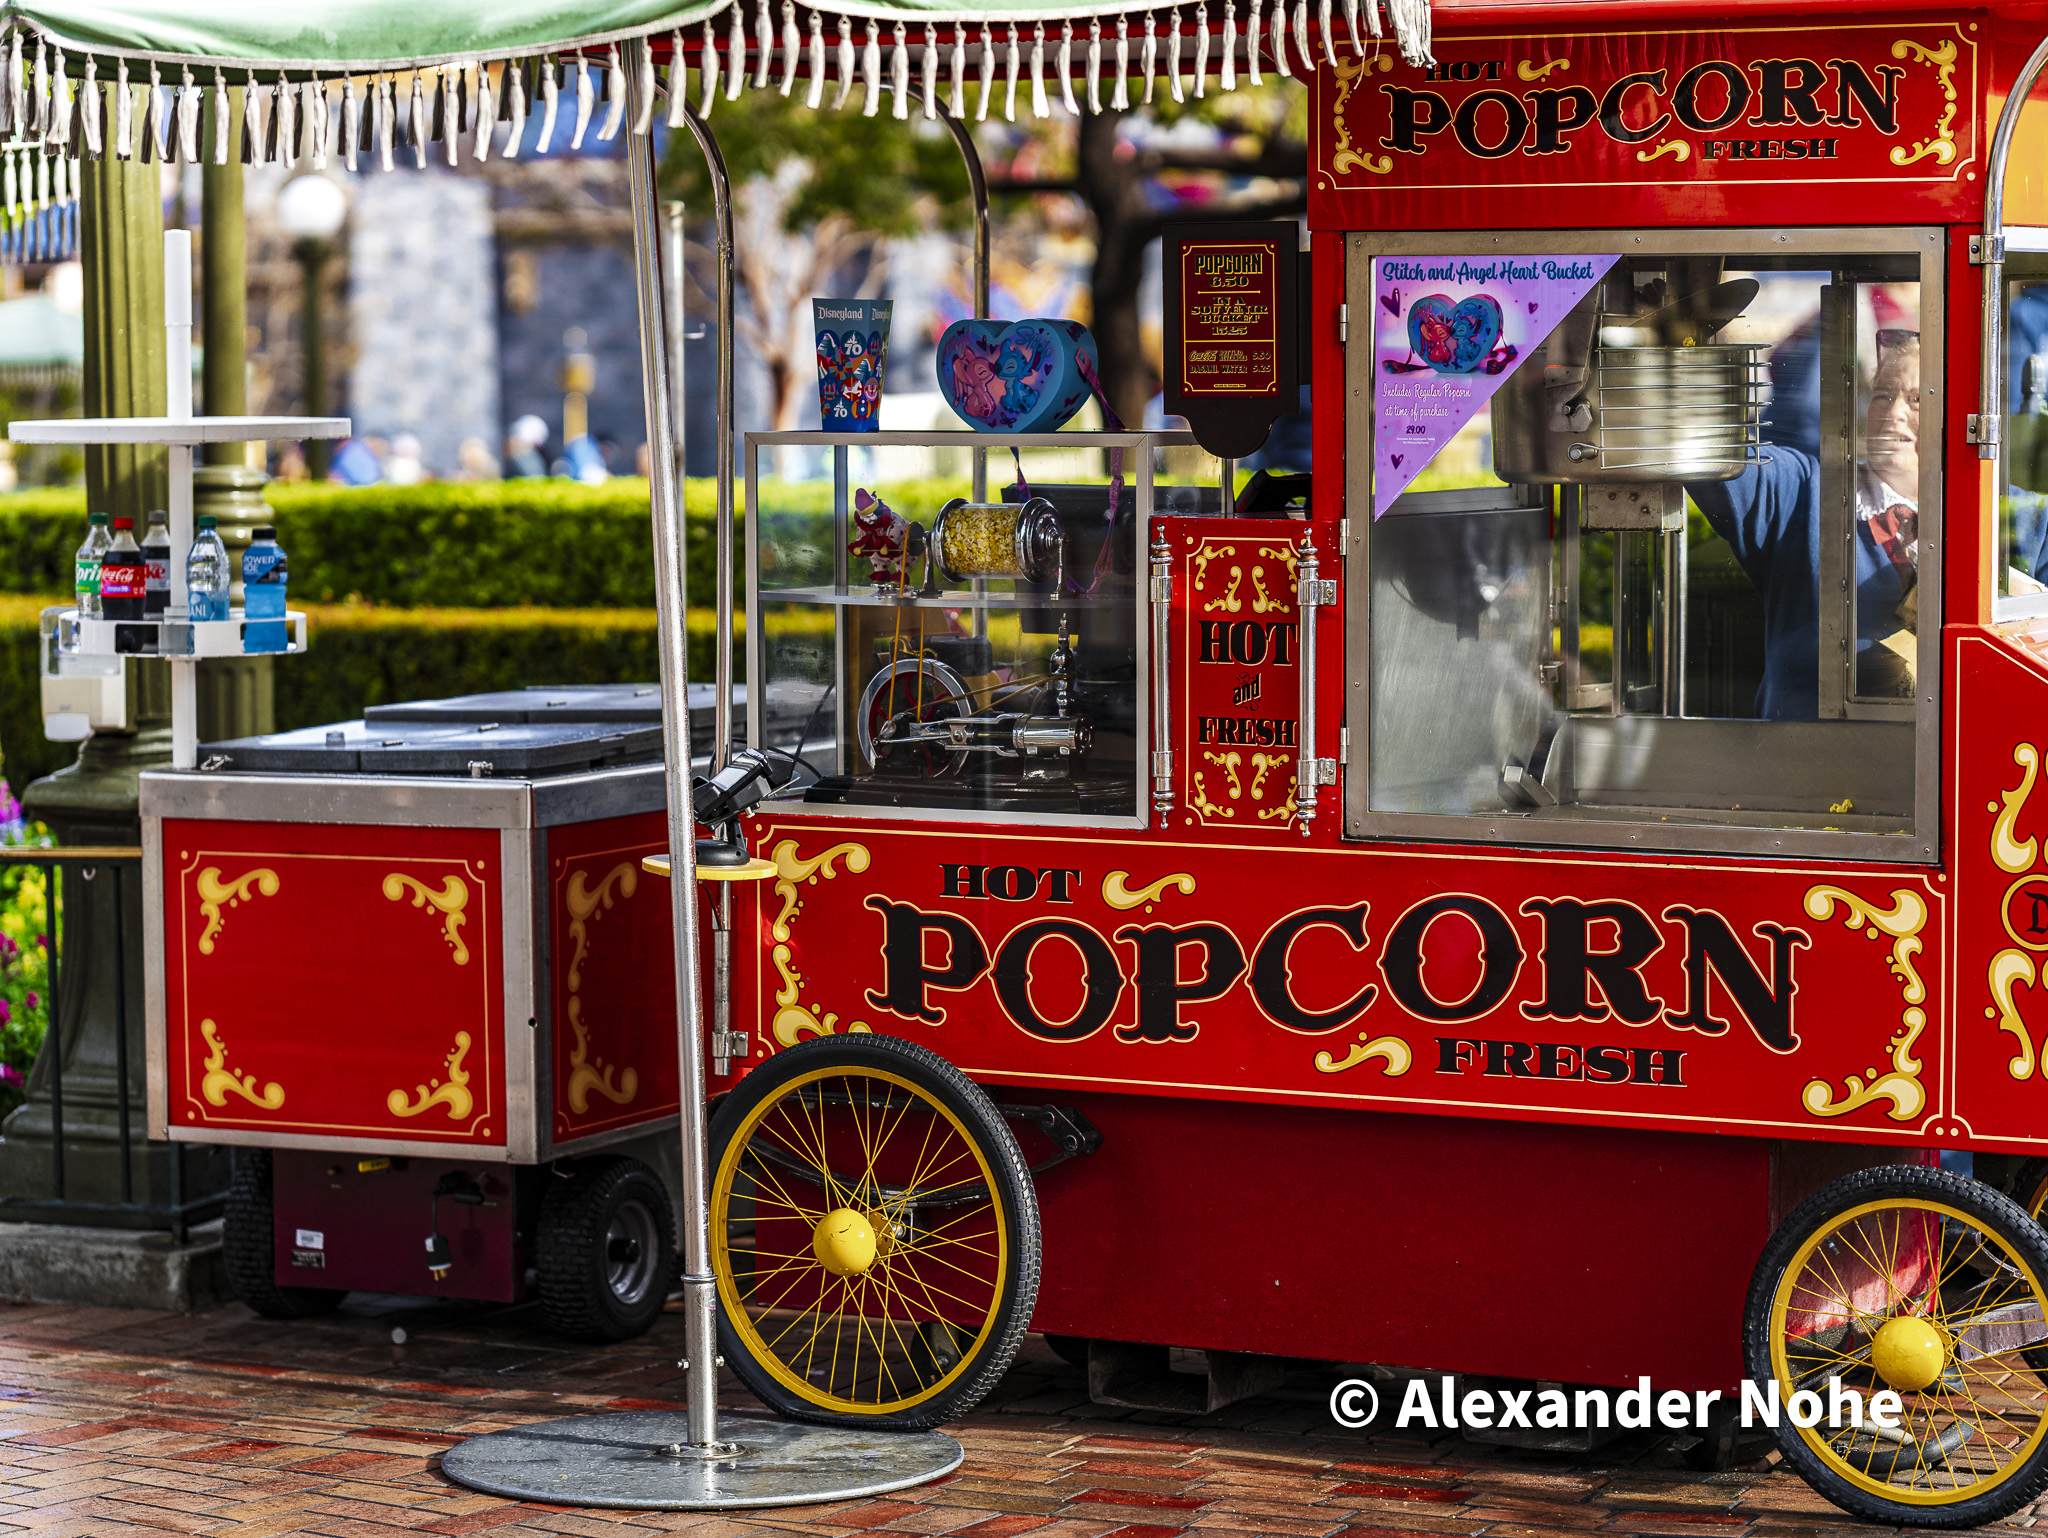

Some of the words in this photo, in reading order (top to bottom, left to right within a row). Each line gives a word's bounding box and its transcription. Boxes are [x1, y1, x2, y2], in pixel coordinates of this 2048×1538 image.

[1424, 61, 1506, 82] HOT
[1379, 58, 1907, 159] POPCORN
[1702, 138, 1839, 161] FRESH
[1195, 253, 1264, 275] POPCORN
[1382, 261, 1426, 282] Stitch
[1428, 262, 1455, 280] and
[1455, 261, 1499, 284] Angel
[1499, 261, 1540, 284] Heart
[1542, 261, 1595, 280] Bucket
[1209, 276, 1249, 287] 6.50
[1191, 305, 1269, 315] SOUVENIR
[1213, 297, 1231, 306] IN
[1235, 297, 1246, 306] A
[817, 306, 863, 320] Disneyland
[1200, 314, 1260, 324] BUCKET
[1212, 326, 1248, 336] 15.25
[844, 343, 863, 356] 70
[1253, 351, 1271, 361] 5.50
[1221, 365, 1248, 374] WATER
[1253, 364, 1271, 373] 5.25
[1382, 382, 1411, 397] Includes
[1414, 383, 1441, 402] Regular
[1442, 383, 1472, 401] Popcorn
[833, 407, 848, 418] 70
[1385, 404, 1393, 416] at
[1393, 404, 1409, 416] time
[1410, 402, 1419, 421] of
[1418, 403, 1449, 420] purchase
[1406, 425, 1426, 434] 29.00
[1198, 620, 1298, 666] HOT
[1233, 672, 1262, 706] and
[1198, 716, 1297, 748] FRESH
[938, 863, 1081, 904] HOT
[864, 892, 1812, 1055] POPCORN
[1434, 1037, 1688, 1087] FRESH
